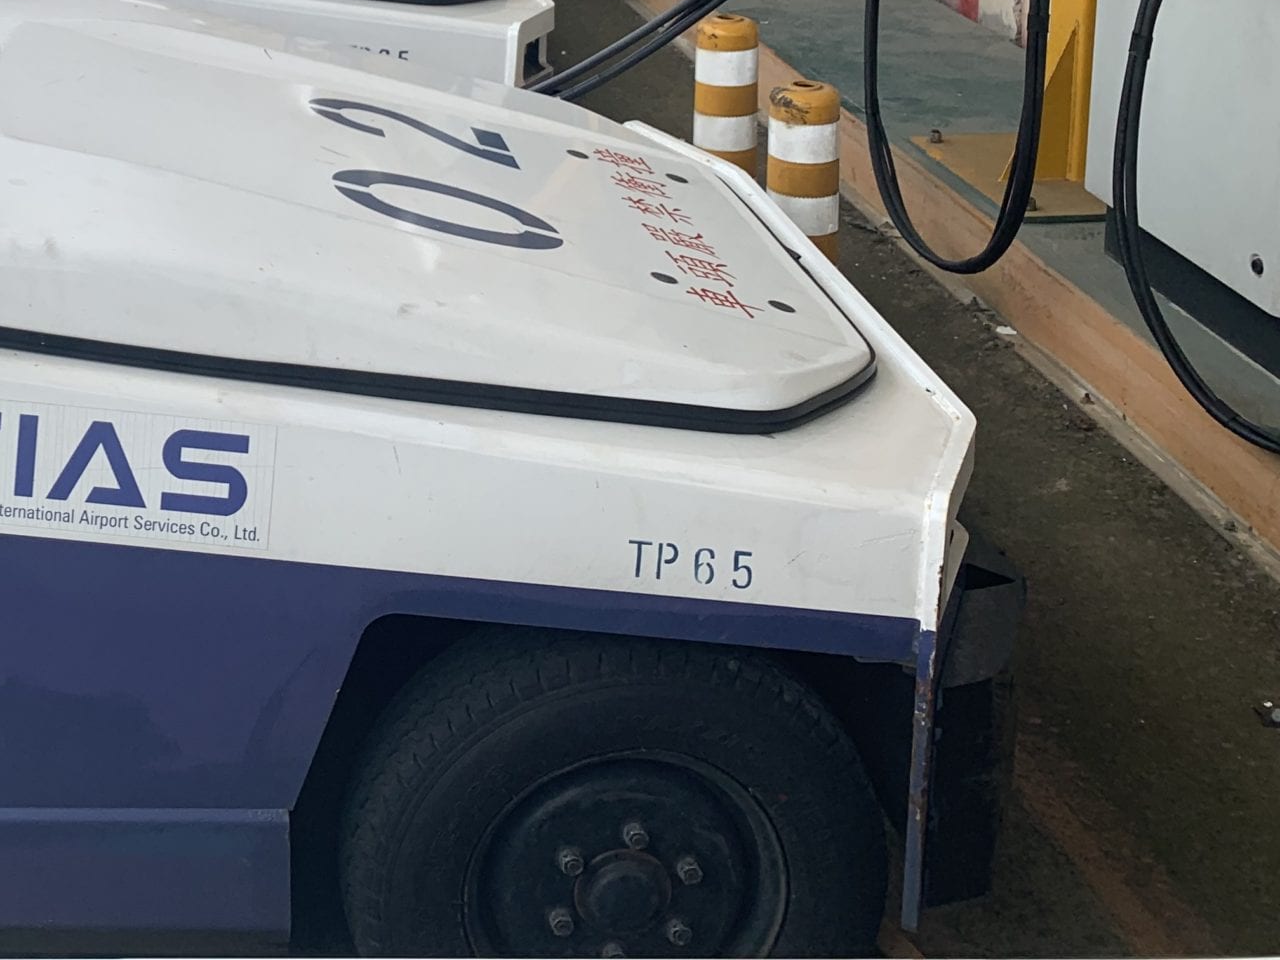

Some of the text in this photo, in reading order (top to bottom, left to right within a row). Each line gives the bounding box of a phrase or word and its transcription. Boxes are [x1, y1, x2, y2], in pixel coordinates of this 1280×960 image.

[309, 97, 564, 250] 02
[593, 148, 765, 319] 車頭嚴禁衝撞
[79, 509, 129, 530] Airport
[133, 515, 195, 536] Services
[200, 521, 228, 540] Co.,
[234, 525, 260, 542] Ltd.
